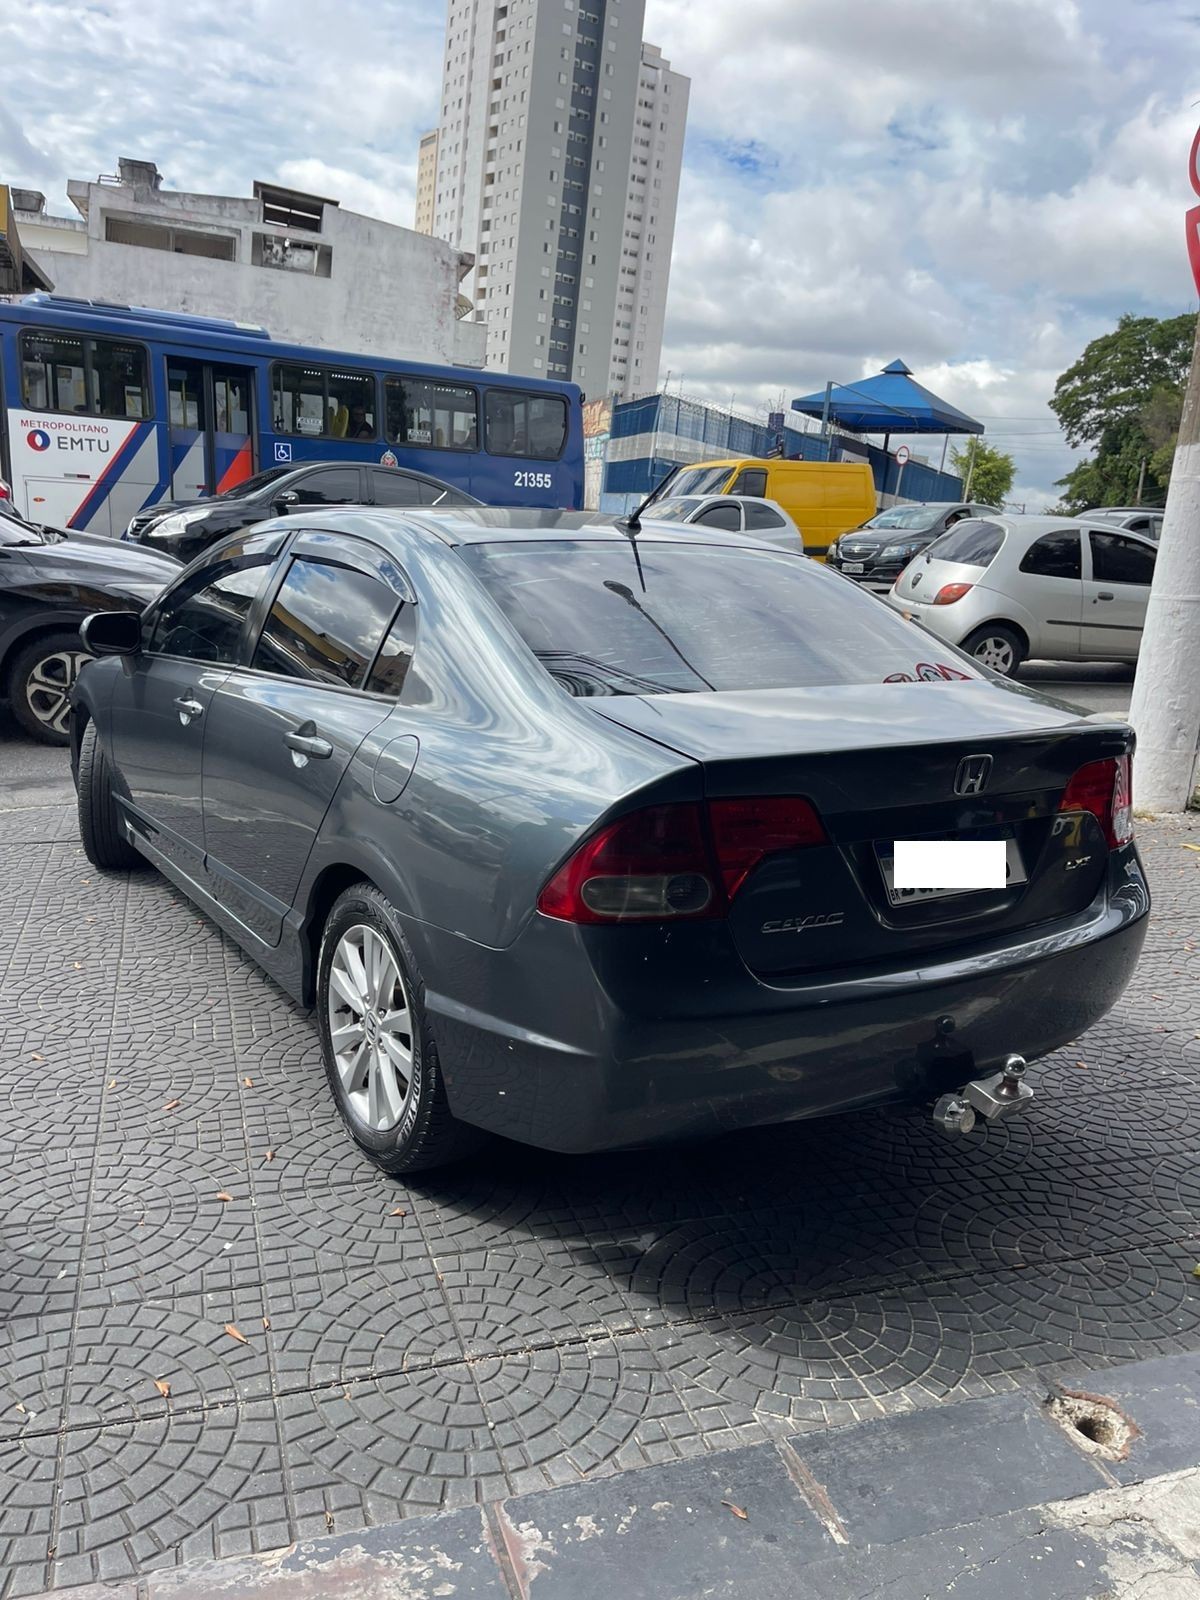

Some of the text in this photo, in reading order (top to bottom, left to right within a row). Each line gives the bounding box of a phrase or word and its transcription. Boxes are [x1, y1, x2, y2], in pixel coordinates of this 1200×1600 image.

[20, 419, 108, 433] METROPOLITANO
[57, 436, 110, 453] EMTU
[514, 471, 552, 488] 21355
